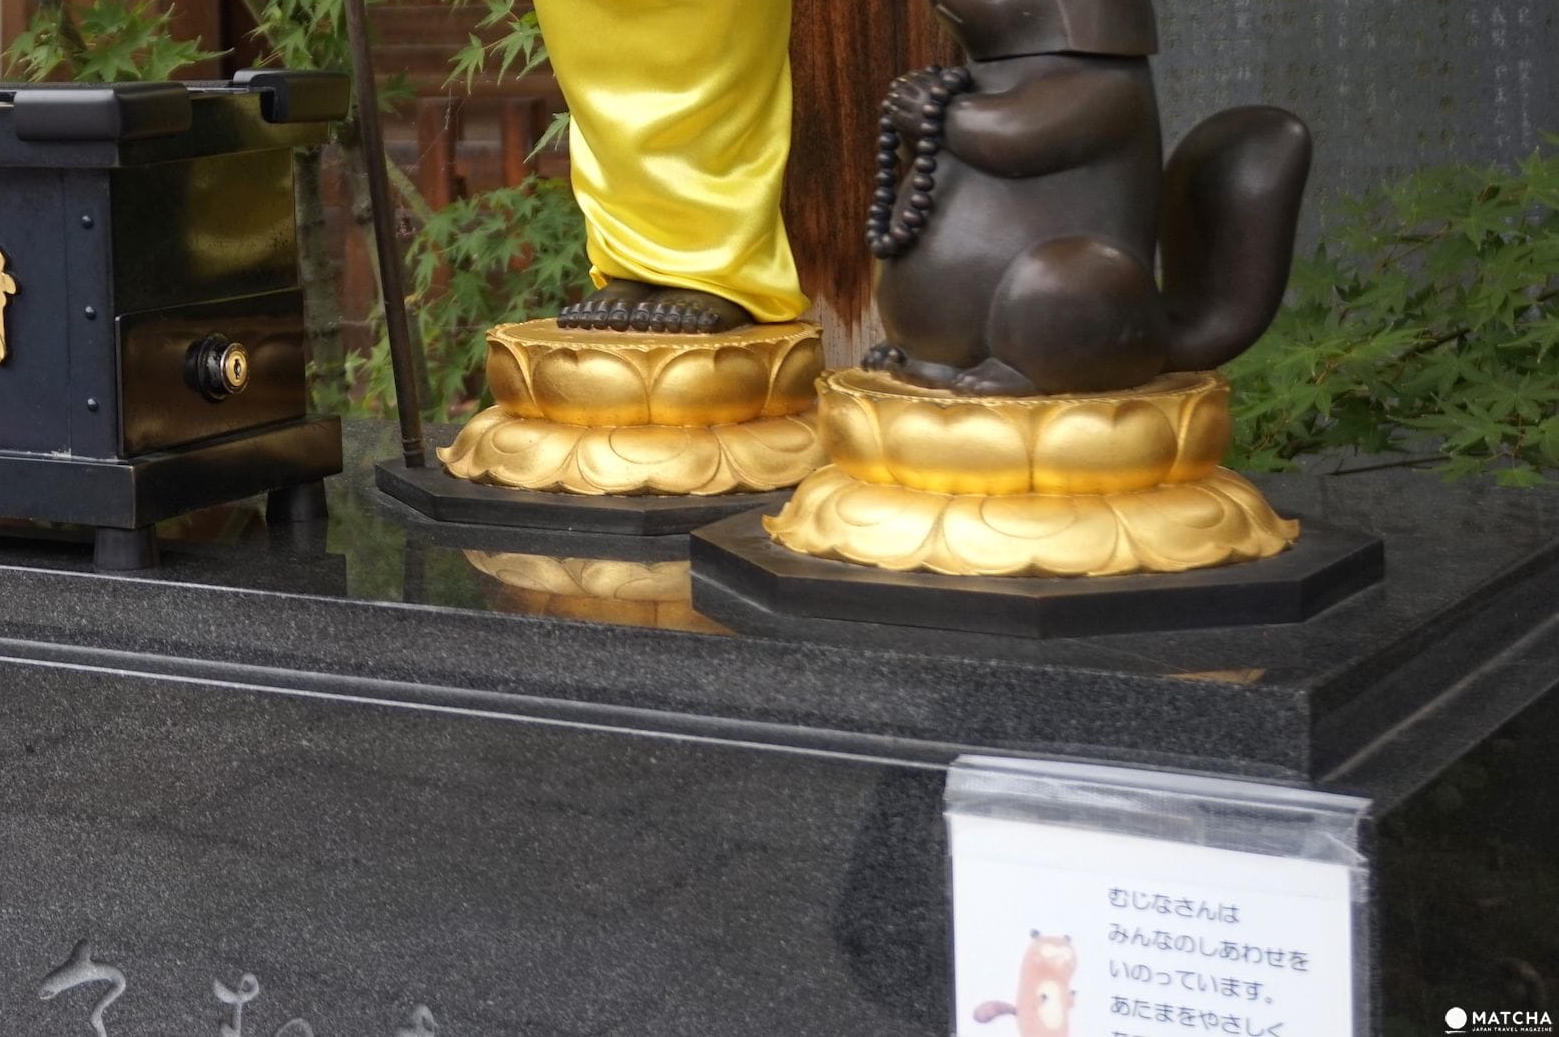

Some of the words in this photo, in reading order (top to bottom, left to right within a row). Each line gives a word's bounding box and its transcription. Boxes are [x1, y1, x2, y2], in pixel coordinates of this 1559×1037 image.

[1108, 886, 1241, 925] むじなさんは
[1107, 922, 1311, 973] みんなのしあわせを
[1109, 959, 1275, 1005] いのっています。
[1109, 994, 1285, 1037] あたまをやさしく
